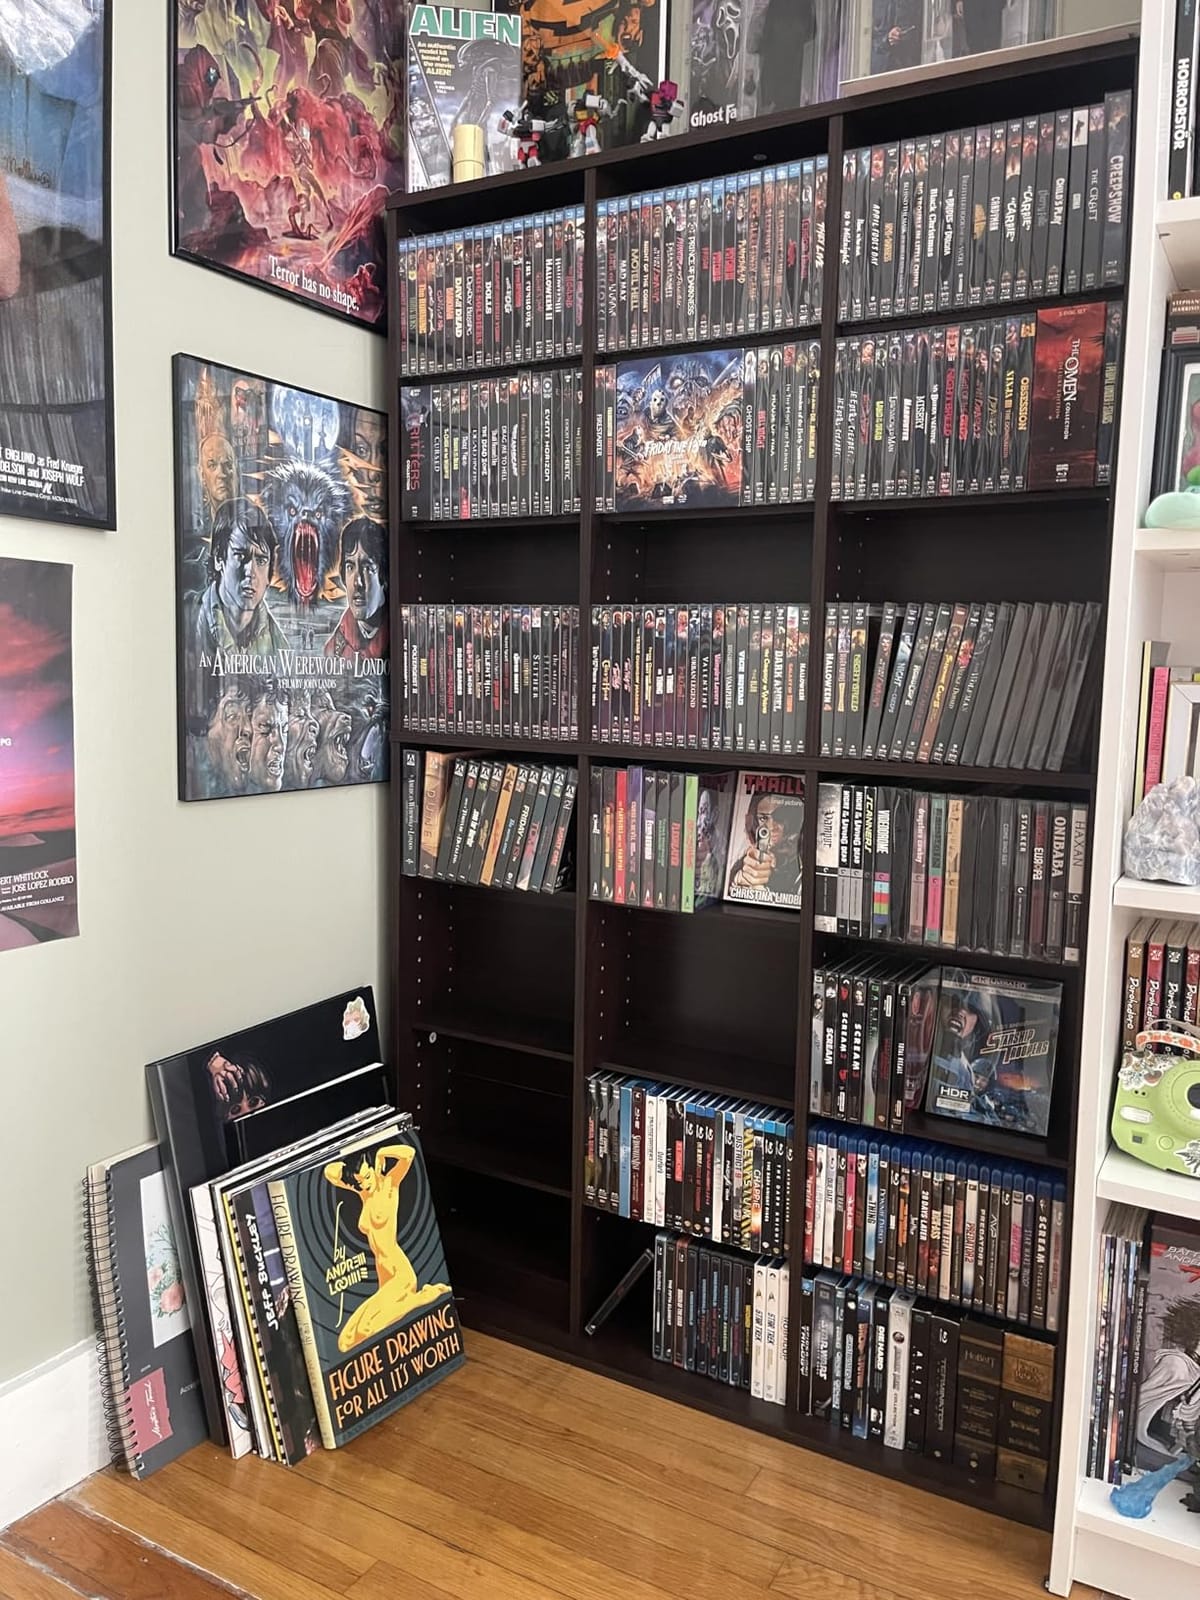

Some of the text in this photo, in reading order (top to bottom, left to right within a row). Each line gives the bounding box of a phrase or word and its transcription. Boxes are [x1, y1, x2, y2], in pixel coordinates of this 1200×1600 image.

[410, 5, 521, 47] ALIEN
[691, 107, 724, 127] Ghost
[1173, 57, 1191, 150] HORRORSTÖR
[1088, 168, 1100, 222] THE CRAFT
[1107, 155, 1125, 224] CREEPSHOW
[872, 204, 881, 227] APRIL
[915, 195, 924, 230] TROUBLE
[927, 188, 938, 258] Black Christmas
[989, 196, 1001, 231] CANDYMAN
[1051, 204, 1063, 225] PLAY
[688, 236, 696, 266] PRINCE
[816, 222, 825, 269] THEY LIVE
[840, 226, 851, 265] Midnight
[871, 251, 880, 266] DAY
[914, 241, 922, 263] LITTLE
[268, 254, 360, 314] Terror has no shape.
[545, 258, 553, 321] HALLOWEEN II
[630, 248, 639, 311] MOTEL HELL
[687, 274, 695, 316] DARKNESS
[912, 264, 921, 288] CHINA
[455, 277, 463, 338] DAY DEAD
[1062, 356, 1080, 401] OMEN
[914, 395, 926, 430] MISERY
[1017, 377, 1029, 431] OBSESSION
[5, 447, 84, 475] ENGLUND as Fred Krueger
[27, 467, 39, 479] and
[41, 468, 65, 483] JOSEPH
[65, 473, 85, 487] WOLF
[199, 651, 212, 667] AN
[211, 646, 277, 676] AMERICAN
[277, 648, 346, 677] WEREWOLF
[354, 651, 390, 678] LONDO
[532, 654, 540, 699] SLITHER
[773, 650, 783, 679] DARK
[823, 653, 834, 711] HALLOWEEN 4
[894, 662, 906, 686] NIGHT
[0, 737, 11, 746] PG
[517, 804, 530, 837] FRIDAY
[840, 790, 851, 863] NIGHT LIVING DEAD
[853, 790, 863, 864] NIGHT LIVING DEAD
[864, 794, 874, 853] SCANNERS
[876, 809, 890, 855] VIDEODROME
[1019, 814, 1029, 852] STALKER
[1051, 816, 1067, 878] ONIBABA
[12, 875, 74, 894] JOSE LOPEZ RODERO
[13, 870, 49, 883] WHITLOCK
[730, 887, 774, 902] CHRISTINA
[1126, 977, 1139, 1030] Dorohedoro
[824, 1027, 834, 1065] SCREAM
[840, 1012, 848, 1052] SCREAM
[852, 1023, 862, 1071] SCREAM
[984, 1029, 1050, 1065] STARSHIP TROOPERS
[940, 1086, 970, 1099] HDR
[734, 1135, 743, 1179] DISTRICT 9
[742, 1149, 752, 1219] ELYSIUM
[868, 1201, 879, 1225] THING
[919, 1190, 930, 1241] 28 DAYS LATER
[930, 1209, 942, 1240] KICK-ASS
[989, 1214, 998, 1238] AVP
[271, 1193, 306, 1311] FIGURE DRAWING
[334, 1245, 346, 1264] by
[977, 1208, 987, 1266] PREDATORS
[1036, 1215, 1048, 1264] SCREAM
[245, 1213, 279, 1331] JEFF BUCKLEY
[755, 1308, 764, 1342] STAR TREK
[767, 1312, 776, 1346] STAR TREK
[327, 1304, 455, 1402] FIGURE DRAWING
[819, 1345, 828, 1380] WARS
[876, 1325, 885, 1370] DIE HARD
[335, 1332, 461, 1430] FOR ALL IT'S WORTH
[914, 1351, 923, 1416] ALIEN
[937, 1357, 947, 1431] TERMINATOR
